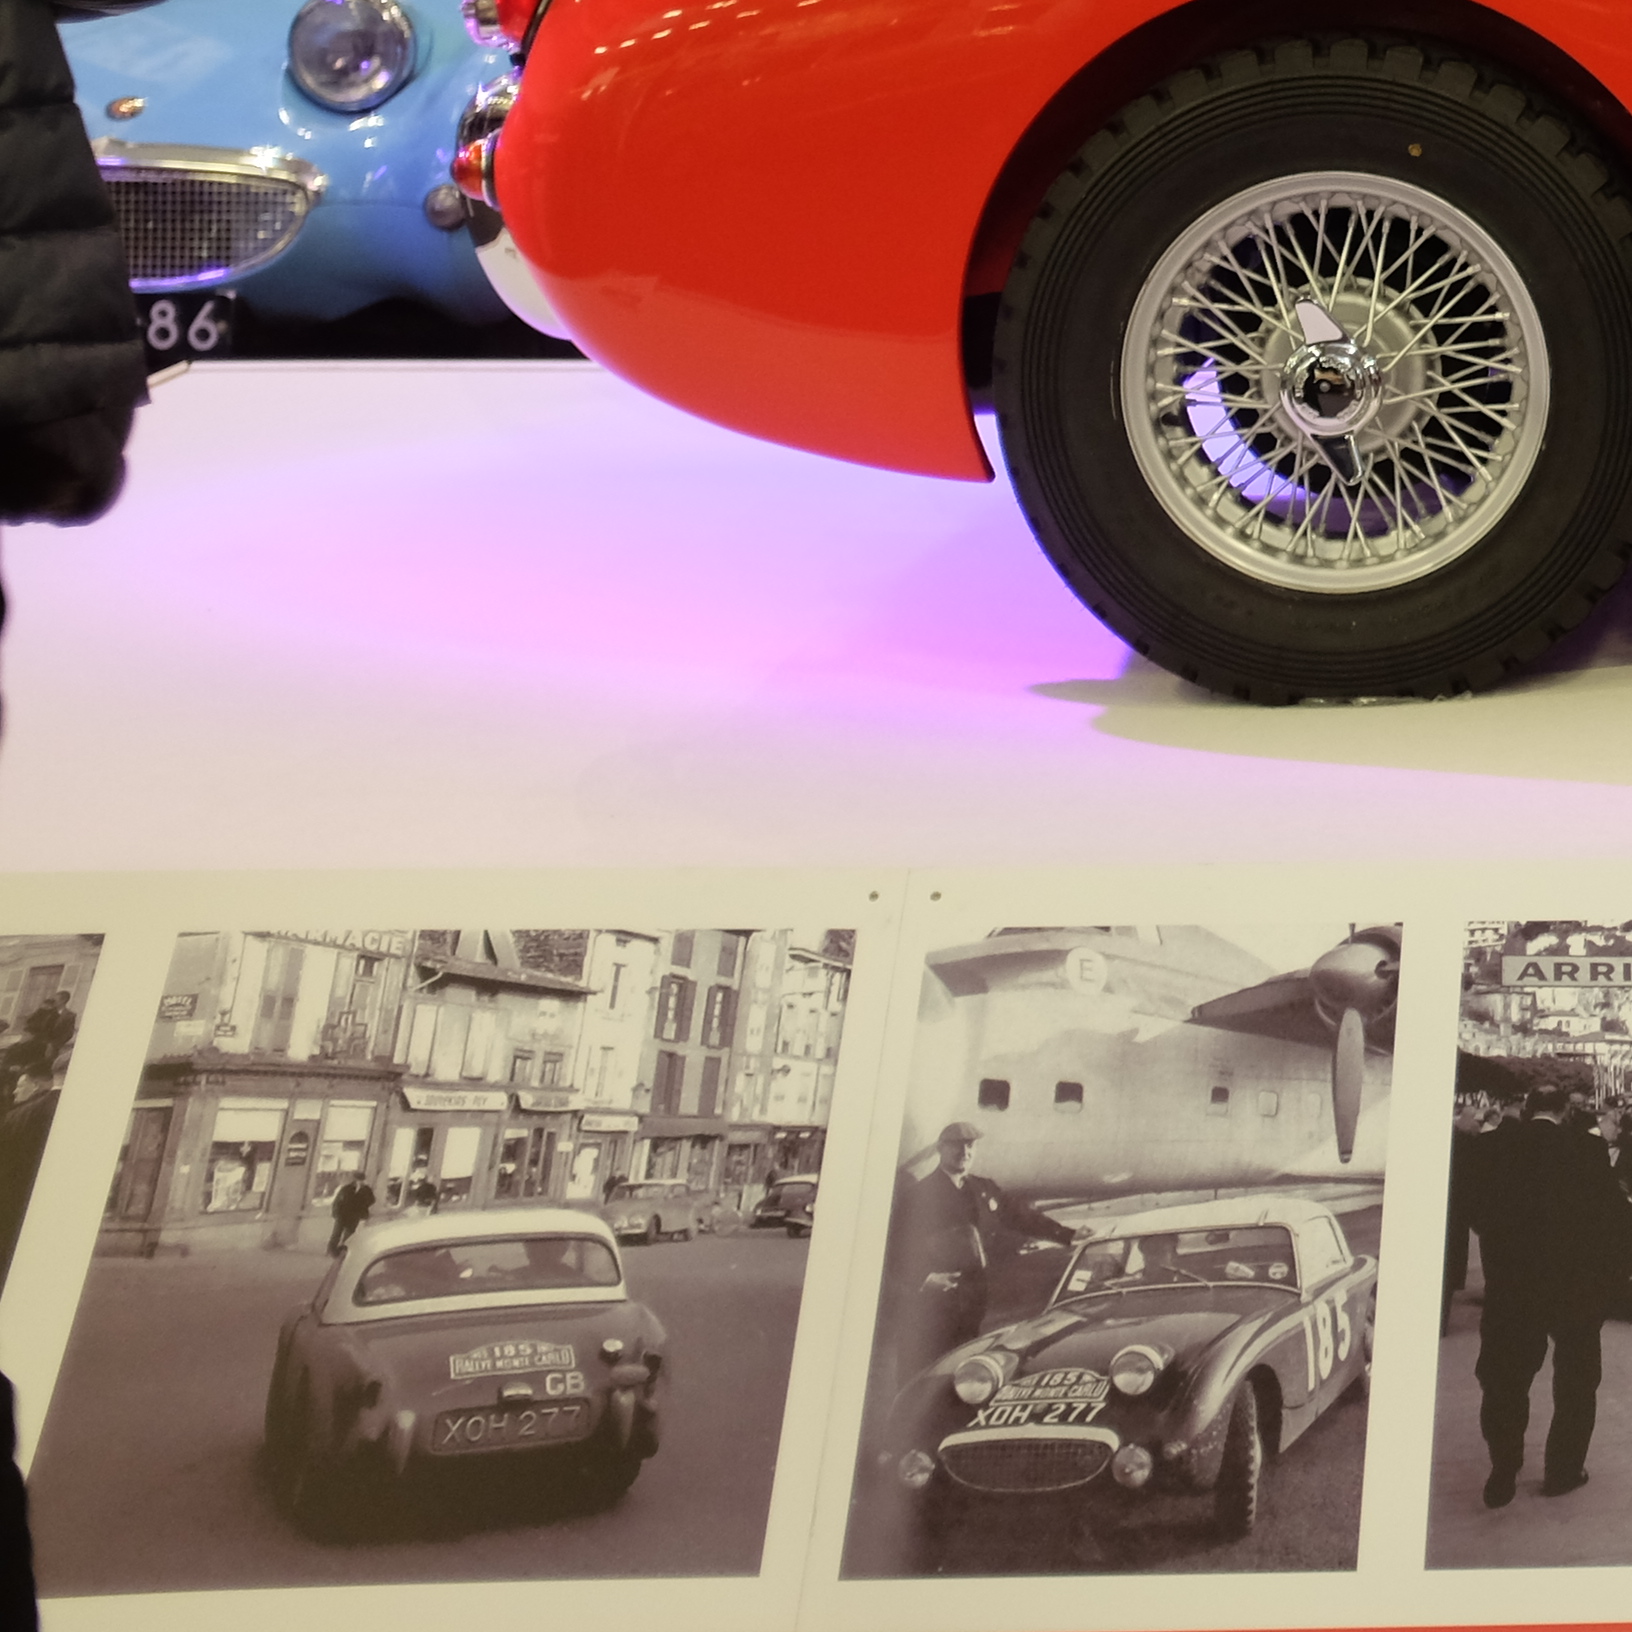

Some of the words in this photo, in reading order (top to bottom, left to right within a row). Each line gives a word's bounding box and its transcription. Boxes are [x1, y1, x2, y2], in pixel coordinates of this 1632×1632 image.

[146, 299, 219, 352] 86
[494, 1343, 533, 1357] 185
[1303, 1288, 1351, 1392] 185
[545, 1371, 585, 1396] GB
[1041, 1372, 1080, 1386] 185
[442, 1413, 510, 1445] XOH
[518, 1405, 582, 1436] 277
[966, 1404, 1034, 1428] XOH
[1042, 1402, 1106, 1423] 277
